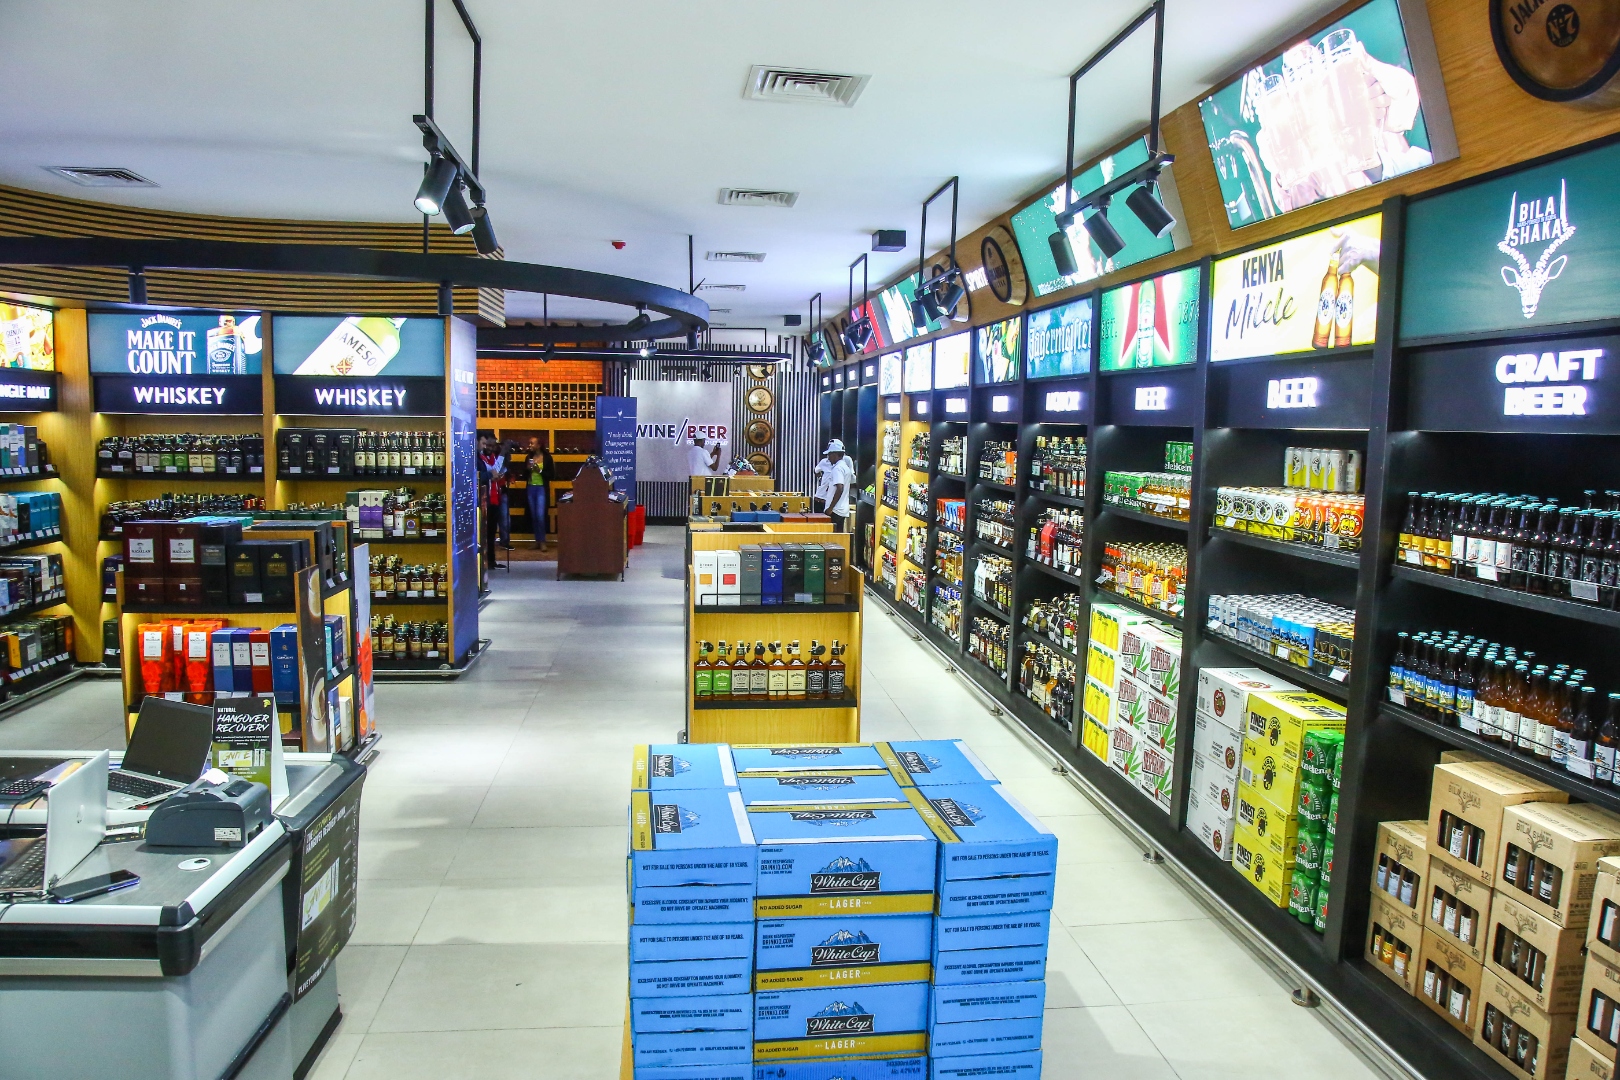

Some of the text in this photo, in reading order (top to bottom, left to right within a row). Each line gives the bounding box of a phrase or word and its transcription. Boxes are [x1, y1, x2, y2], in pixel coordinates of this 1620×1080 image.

[1519, 196, 1555, 222] BILA
[1510, 219, 1562, 246] SHAKA
[1242, 250, 1284, 289] KENYA
[965, 267, 989, 292] SPIRIT
[1226, 288, 1296, 339] Milele
[127, 330, 196, 350] MAKE IT
[127, 350, 197, 374] COUNT
[1495, 349, 1602, 383] CRAFT
[27, 386, 50, 399] MALT
[134, 386, 226, 404] WHISKEY
[315, 388, 406, 406] WHISKEY
[1267, 378, 1316, 408] BEER
[1504, 386, 1587, 416] BEER
[216, 723, 270, 732] RECOVERY
[217, 714, 270, 723] HANGOVER
[1251, 712, 1266, 730] FINEST
[1240, 799, 1255, 818] FINEST
[1516, 823, 1530, 835] BILA
[1237, 843, 1252, 862] FINEST
[814, 874, 875, 889] White Cap
[830, 899, 861, 908] LAGER
[815, 946, 875, 961] White Cap
[830, 970, 861, 979] LAGER
[810, 1017, 870, 1031] White Cap
[825, 1040, 855, 1049] LAGER
